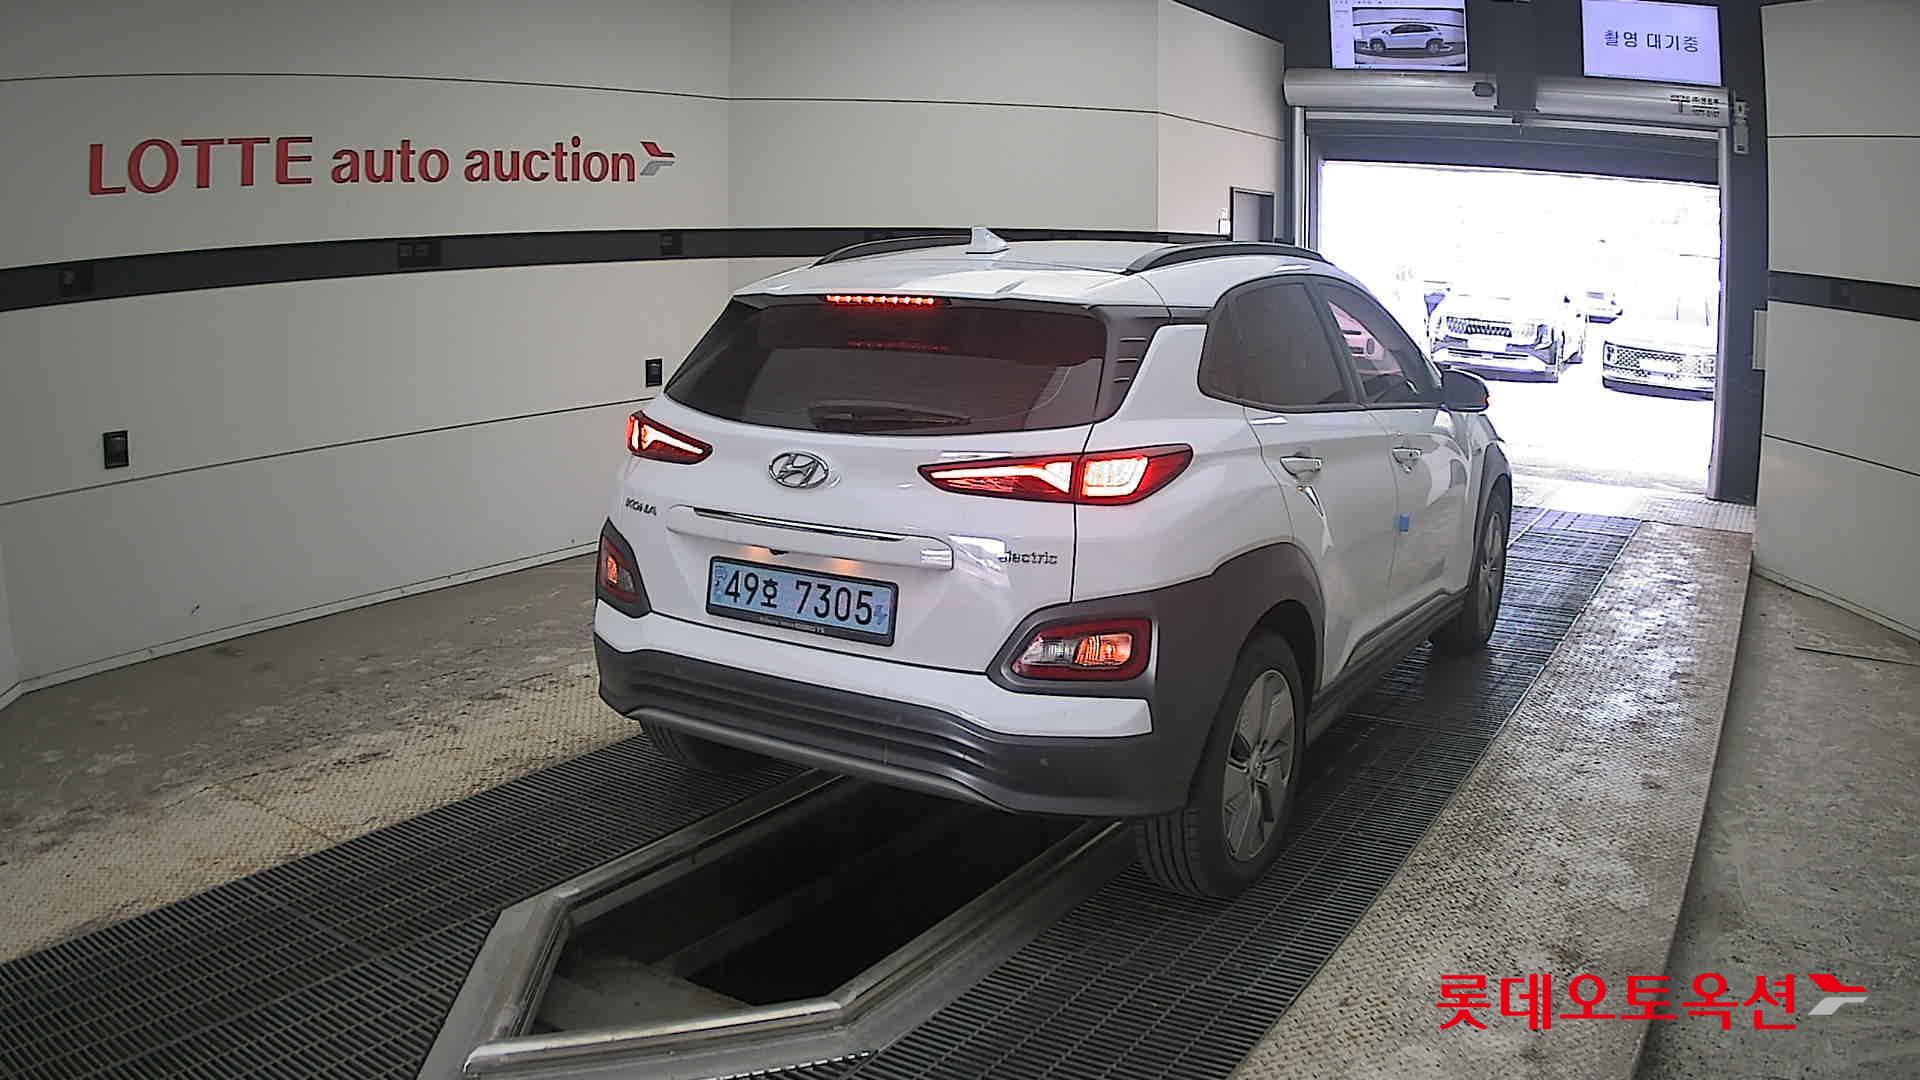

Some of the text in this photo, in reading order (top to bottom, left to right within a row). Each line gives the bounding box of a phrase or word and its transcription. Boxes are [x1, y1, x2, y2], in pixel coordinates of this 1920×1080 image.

[1604, 29, 1699, 53] 촬영 대기중
[89, 136, 636, 195] LOTTE auto auction
[724, 570, 778, 609] 49호
[795, 580, 874, 626] 7305
